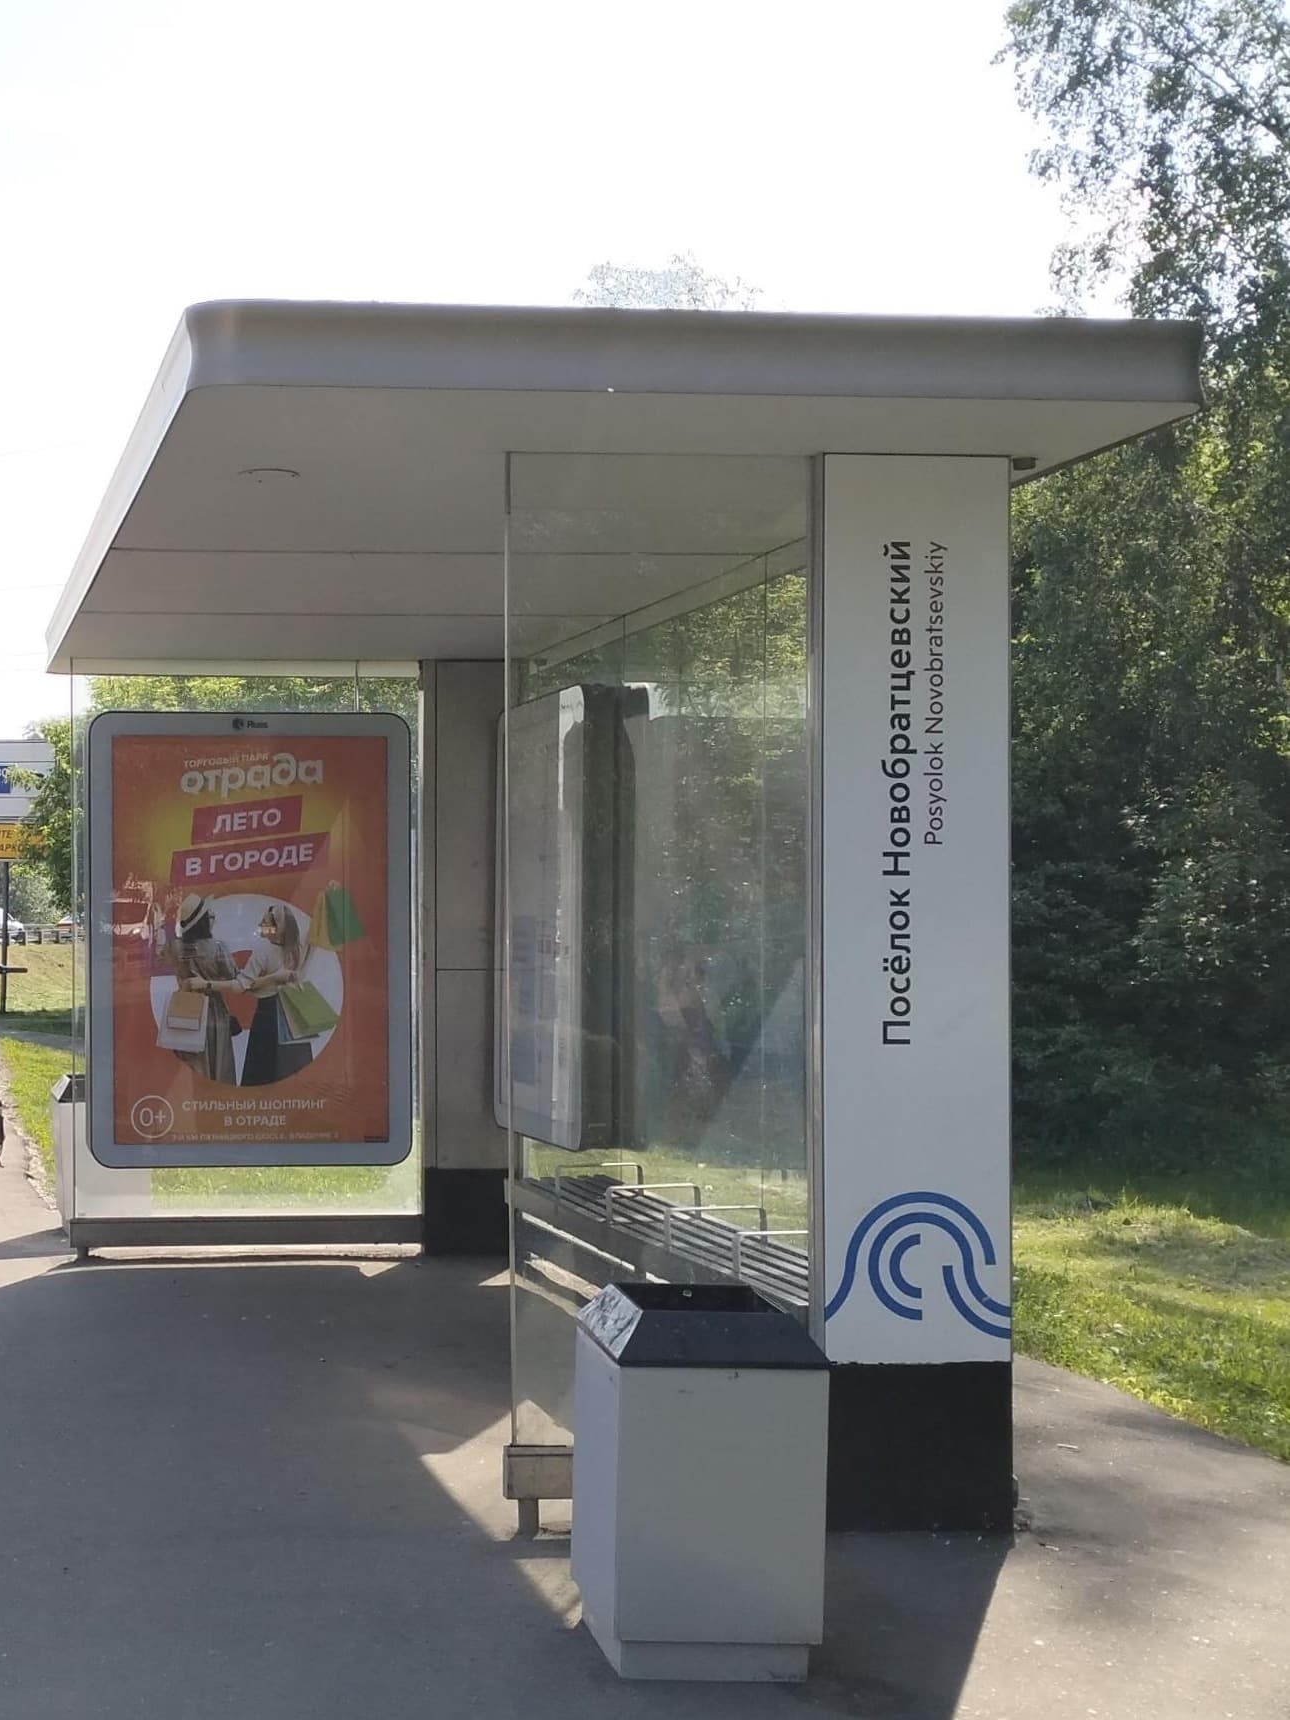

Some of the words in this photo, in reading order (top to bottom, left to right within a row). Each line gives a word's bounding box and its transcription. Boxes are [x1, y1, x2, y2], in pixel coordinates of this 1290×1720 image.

[923, 541, 948, 734] Novobratsevskiy
[881, 541, 917, 876] Новобратцевский
[180, 752, 324, 799] отрада
[923, 742, 947, 845] Posyolok
[213, 807, 282, 834] ЛЕТО
[185, 857, 202, 876] В
[210, 843, 314, 874] ГОРОДЕ
[882, 889, 911, 1045] Посёлок
[140, 1107, 166, 1127] 0+
[181, 1099, 256, 1112] СТИЛЬНЫЙ
[259, 1099, 327, 1110] ШОППИНГ
[224, 1116, 233, 1126] В
[236, 1115, 287, 1127] ОТРАДЕ
